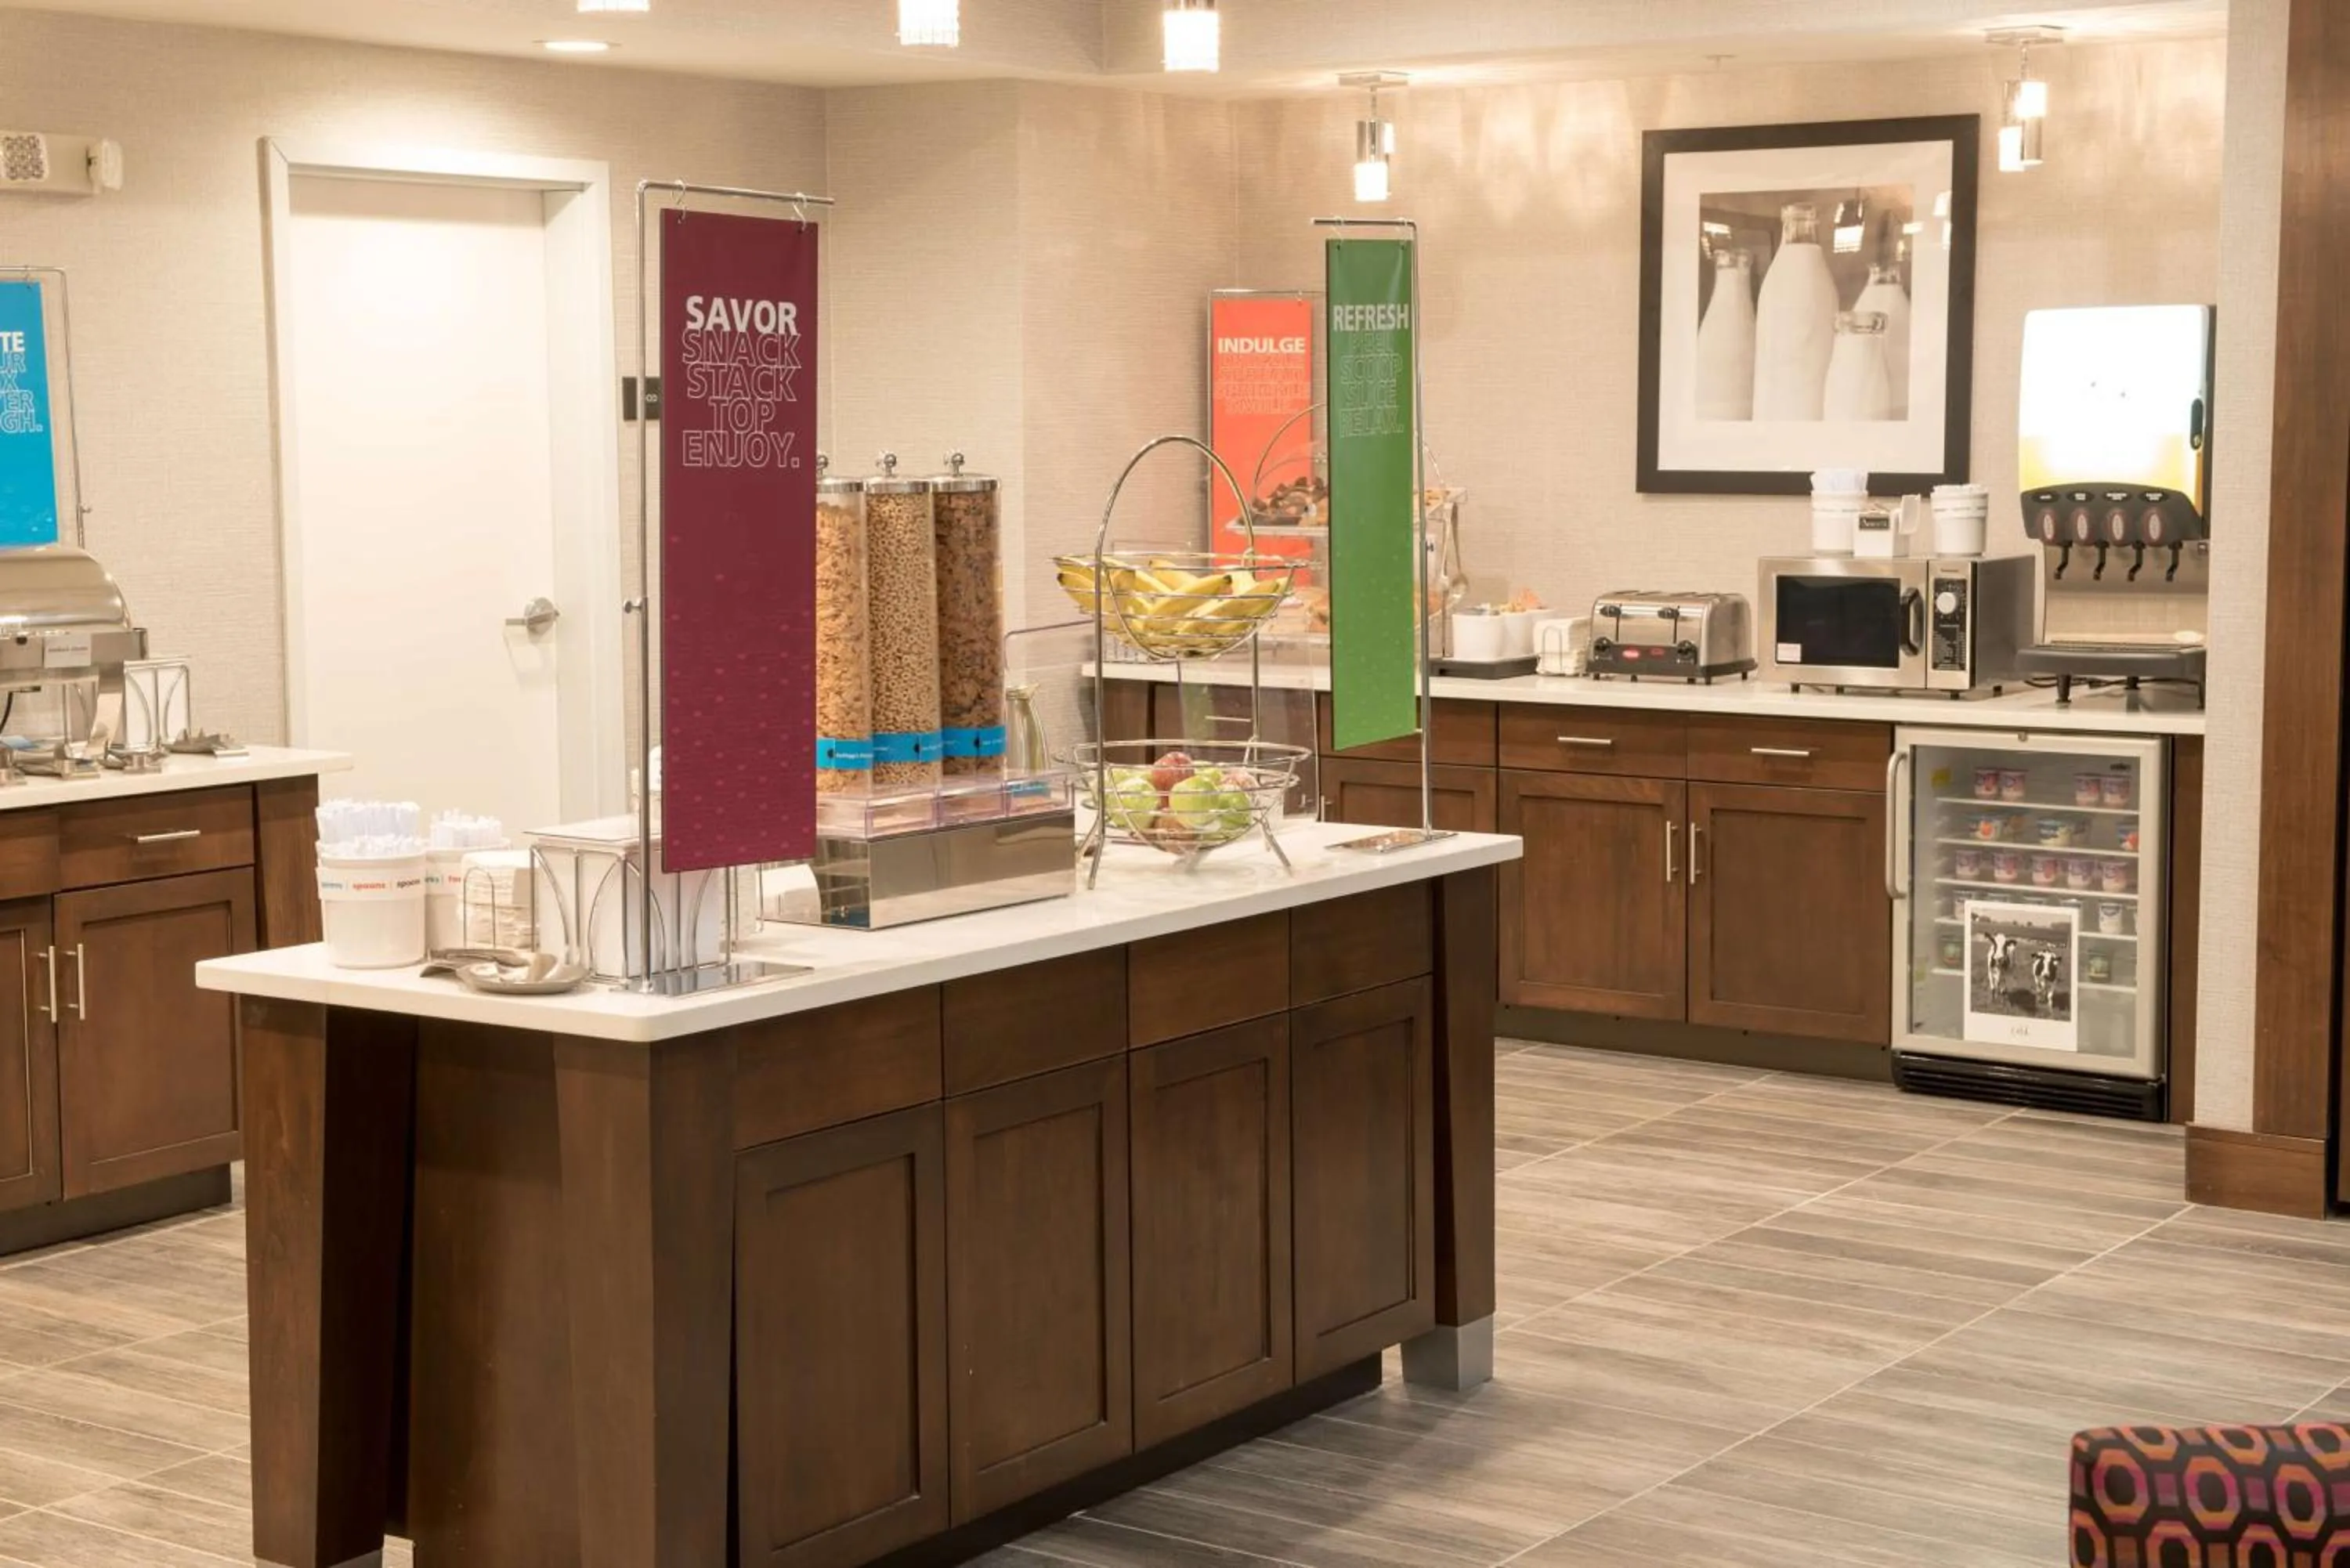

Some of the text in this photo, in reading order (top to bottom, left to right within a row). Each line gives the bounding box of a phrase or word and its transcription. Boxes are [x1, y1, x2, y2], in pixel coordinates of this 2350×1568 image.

[685, 295, 797, 335] SAVOR
[1333, 303, 1409, 331] REFRESH
[682, 328, 801, 368] SNACK
[1217, 337, 1306, 353] INDULGE
[687, 363, 797, 401] STACK
[1340, 352, 1404, 385] SCOOP
[1343, 380, 1397, 409] SLICE
[708, 396, 776, 433] TOP
[682, 430, 801, 468] ENJOY.
